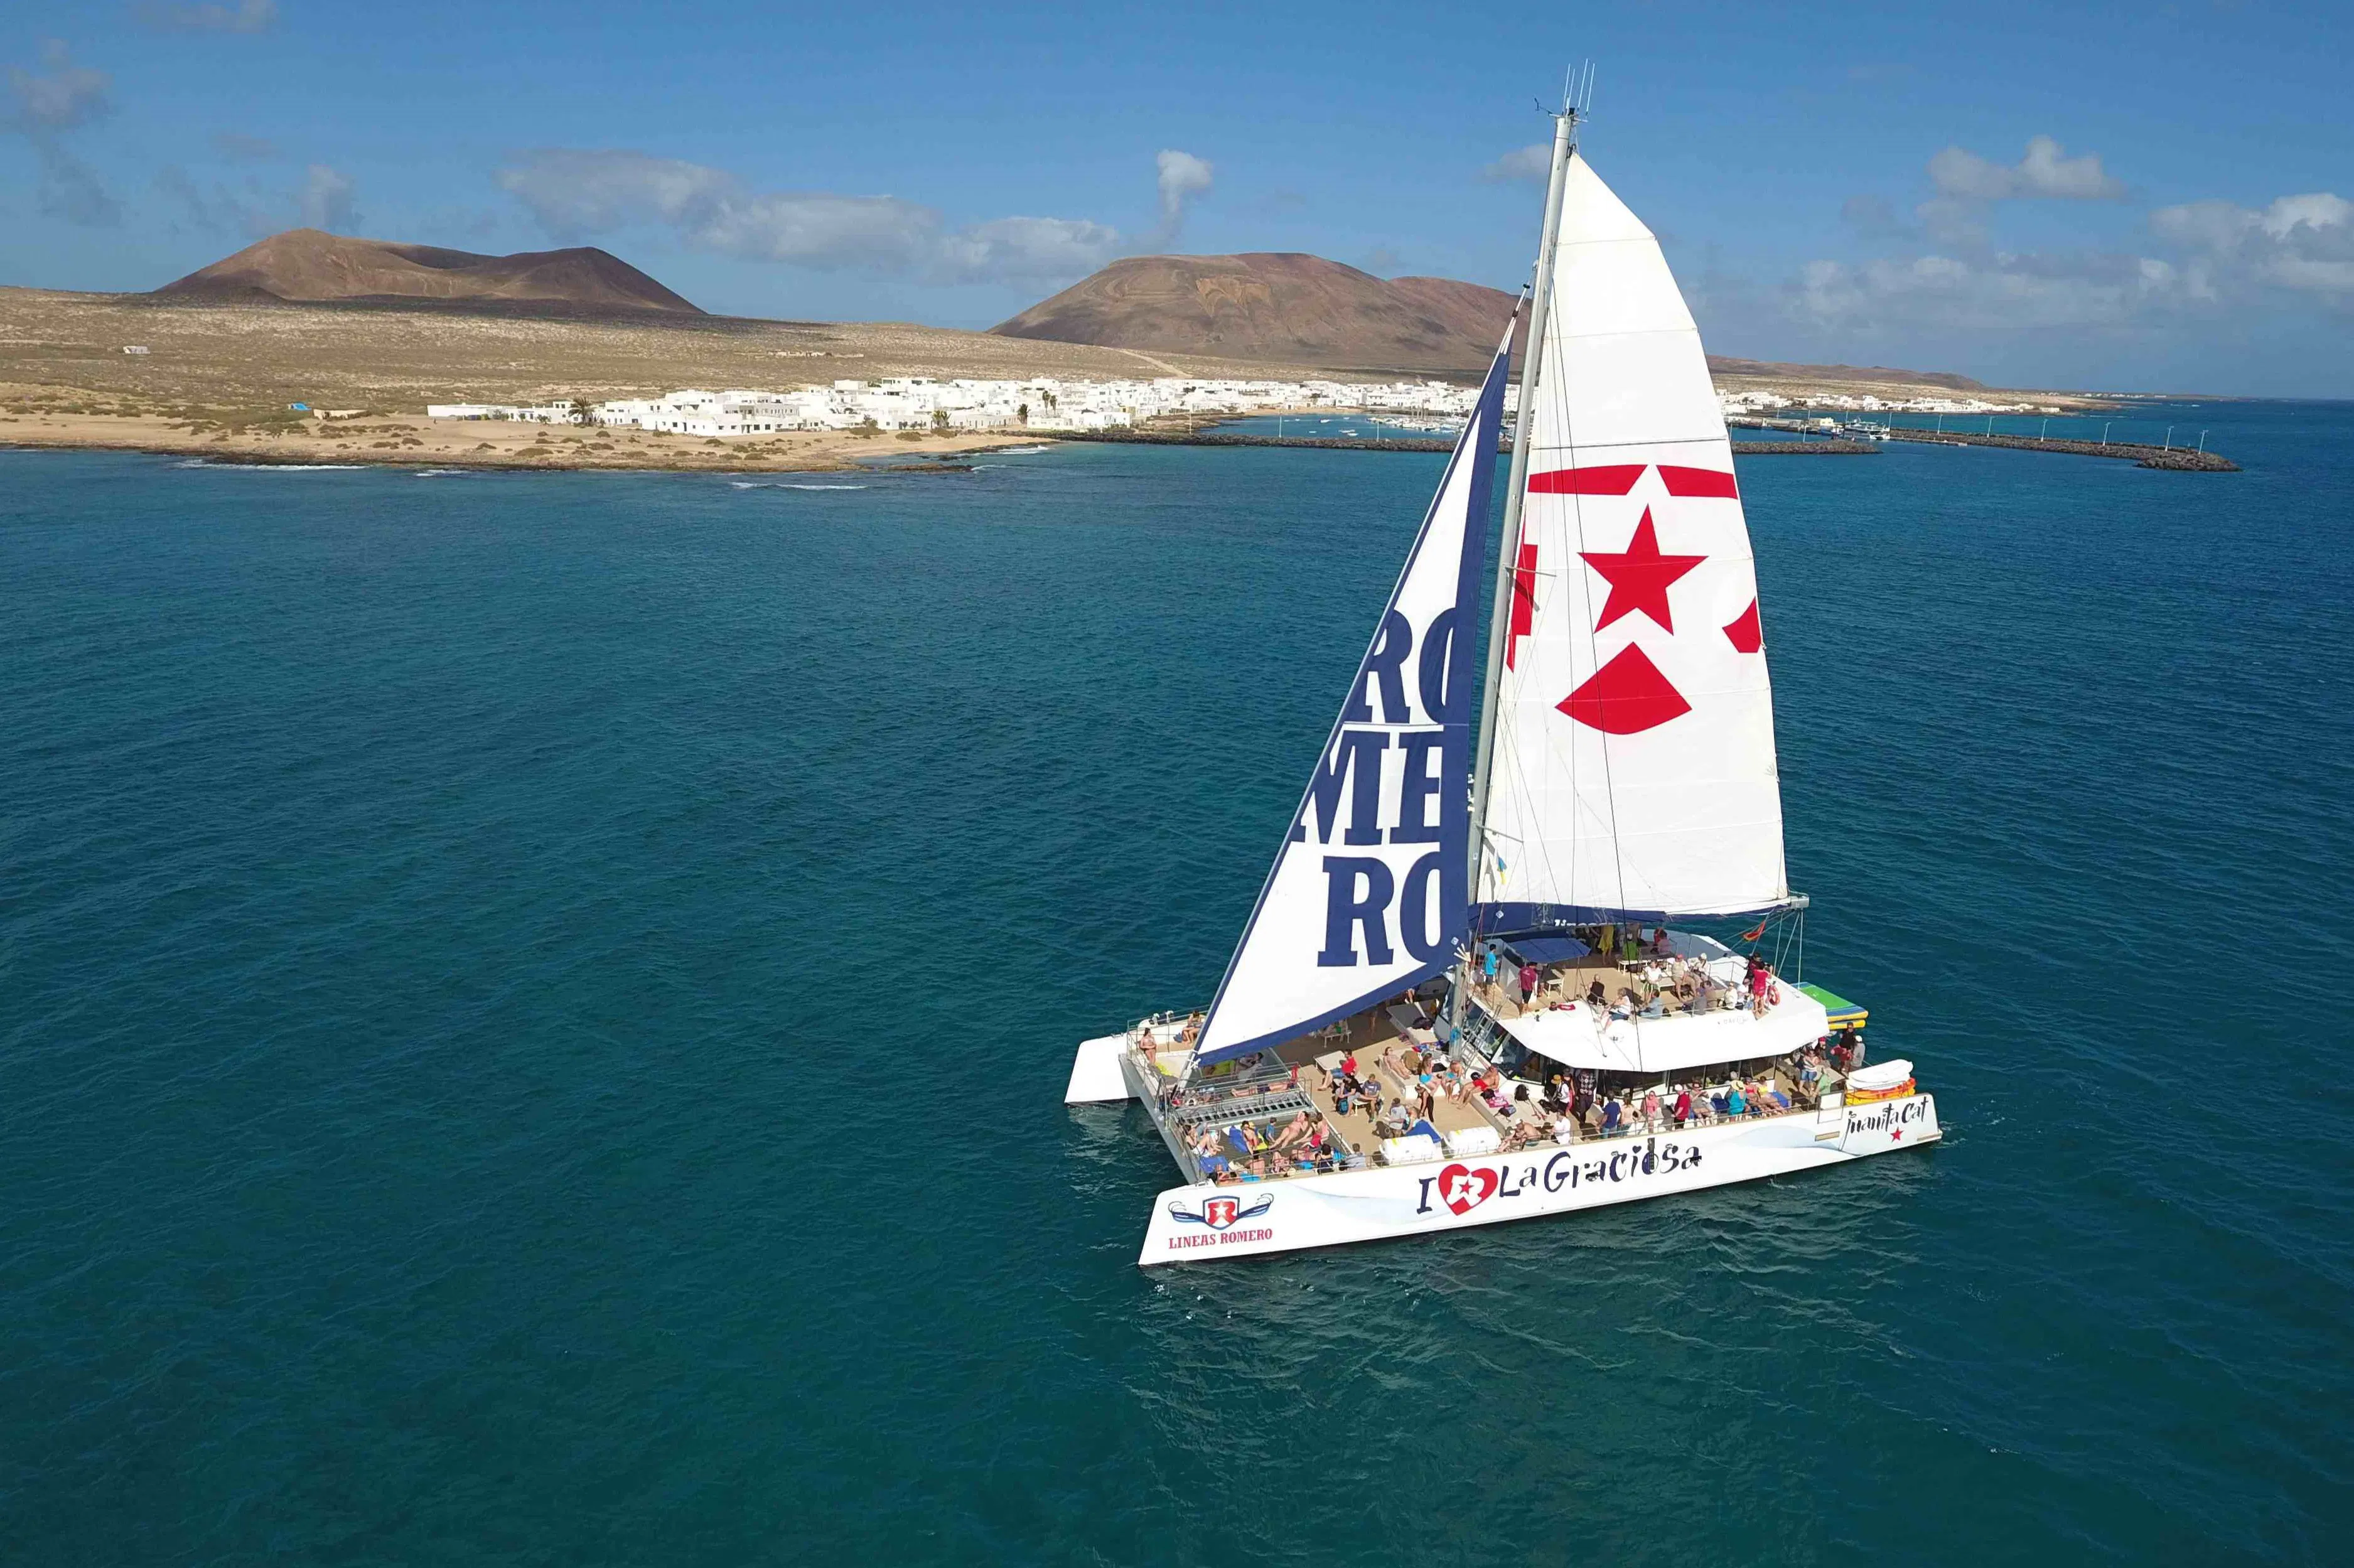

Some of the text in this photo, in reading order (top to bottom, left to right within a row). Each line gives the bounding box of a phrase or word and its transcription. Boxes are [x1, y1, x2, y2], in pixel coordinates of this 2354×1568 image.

[1901, 1096, 1929, 1124] Cat
[1416, 1176, 1438, 1215] I
[1499, 1166, 1537, 1197] La
[1544, 1137, 1702, 1193] Graciosa
[1168, 1228, 1273, 1249] LINEAS ROMERO
